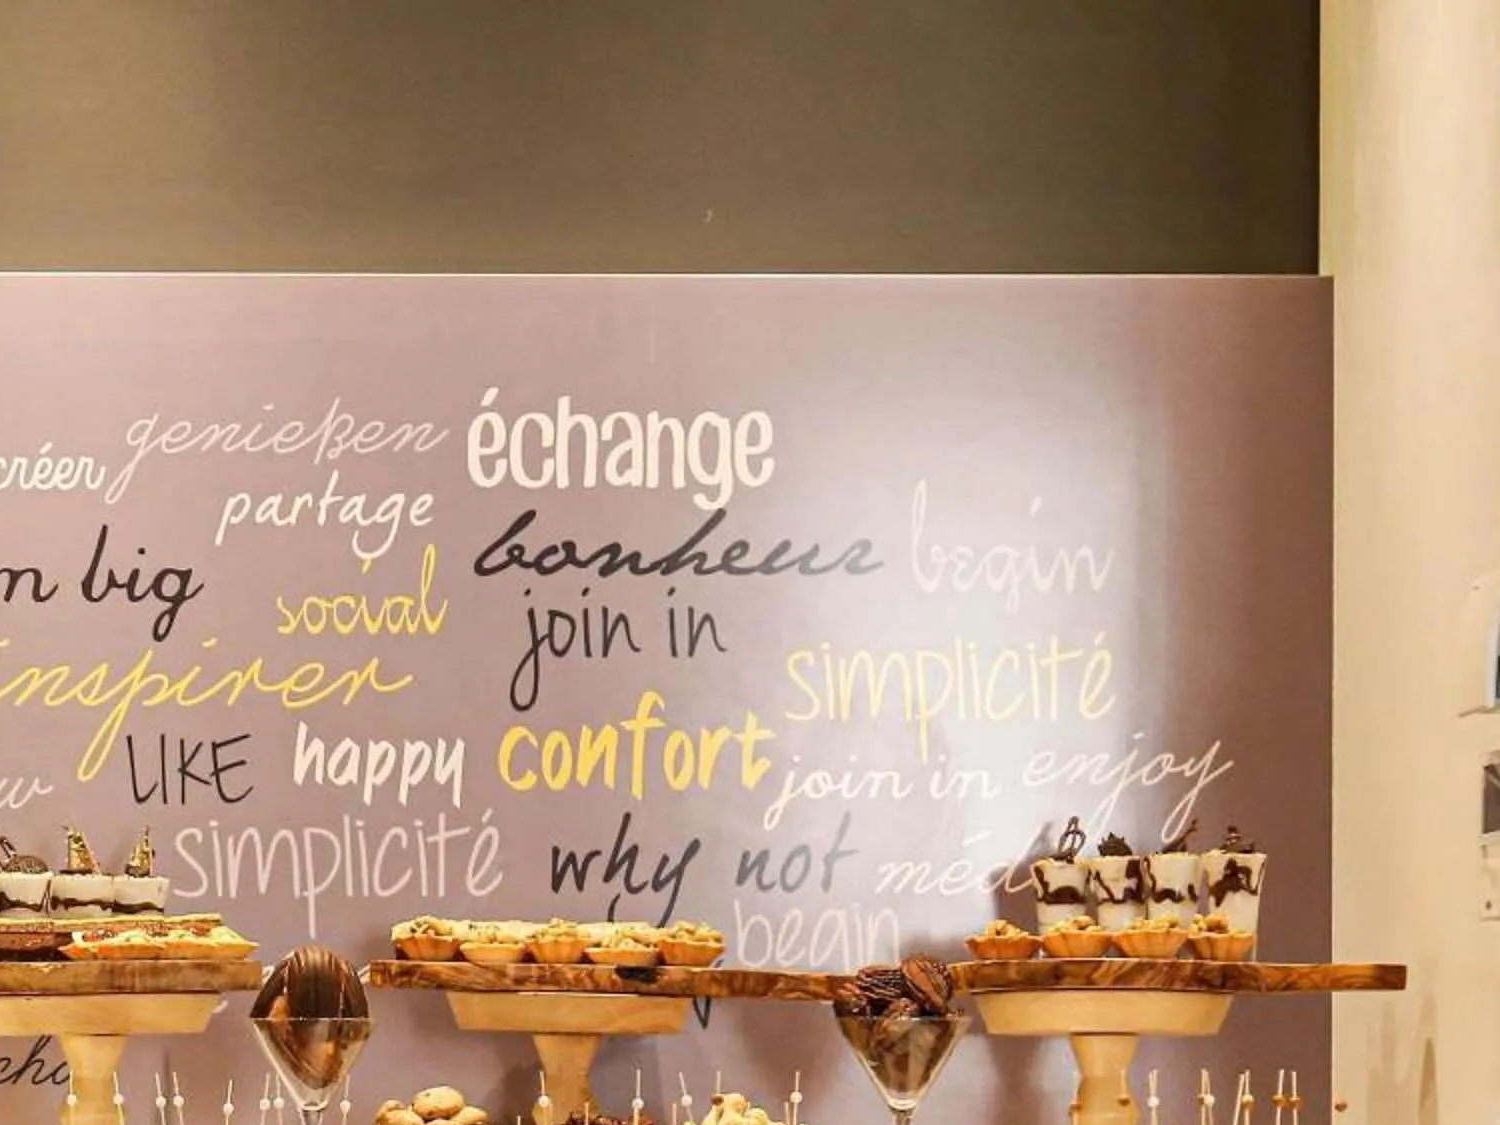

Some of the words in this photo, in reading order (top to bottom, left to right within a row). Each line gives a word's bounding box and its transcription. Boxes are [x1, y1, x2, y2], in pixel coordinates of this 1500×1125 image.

[467, 387, 775, 510] échange
[215, 470, 434, 560] partage
[473, 507, 884, 579] bonheur
[911, 479, 1116, 613] begin
[81, 524, 205, 643] big
[276, 543, 449, 636] social
[509, 588, 642, 712] join
[667, 588, 728, 660] in
[785, 629, 1117, 763] simplicité
[125, 733, 255, 805] LIKE
[293, 721, 466, 808] happy
[497, 691, 779, 801] confort
[764, 755, 915, 832] join
[929, 755, 1000, 802] in
[1022, 732, 1235, 844] enjoy
[173, 808, 505, 939] simplicité
[550, 811, 702, 931] why
[734, 810, 861, 894] not
[732, 899, 902, 972] begin
